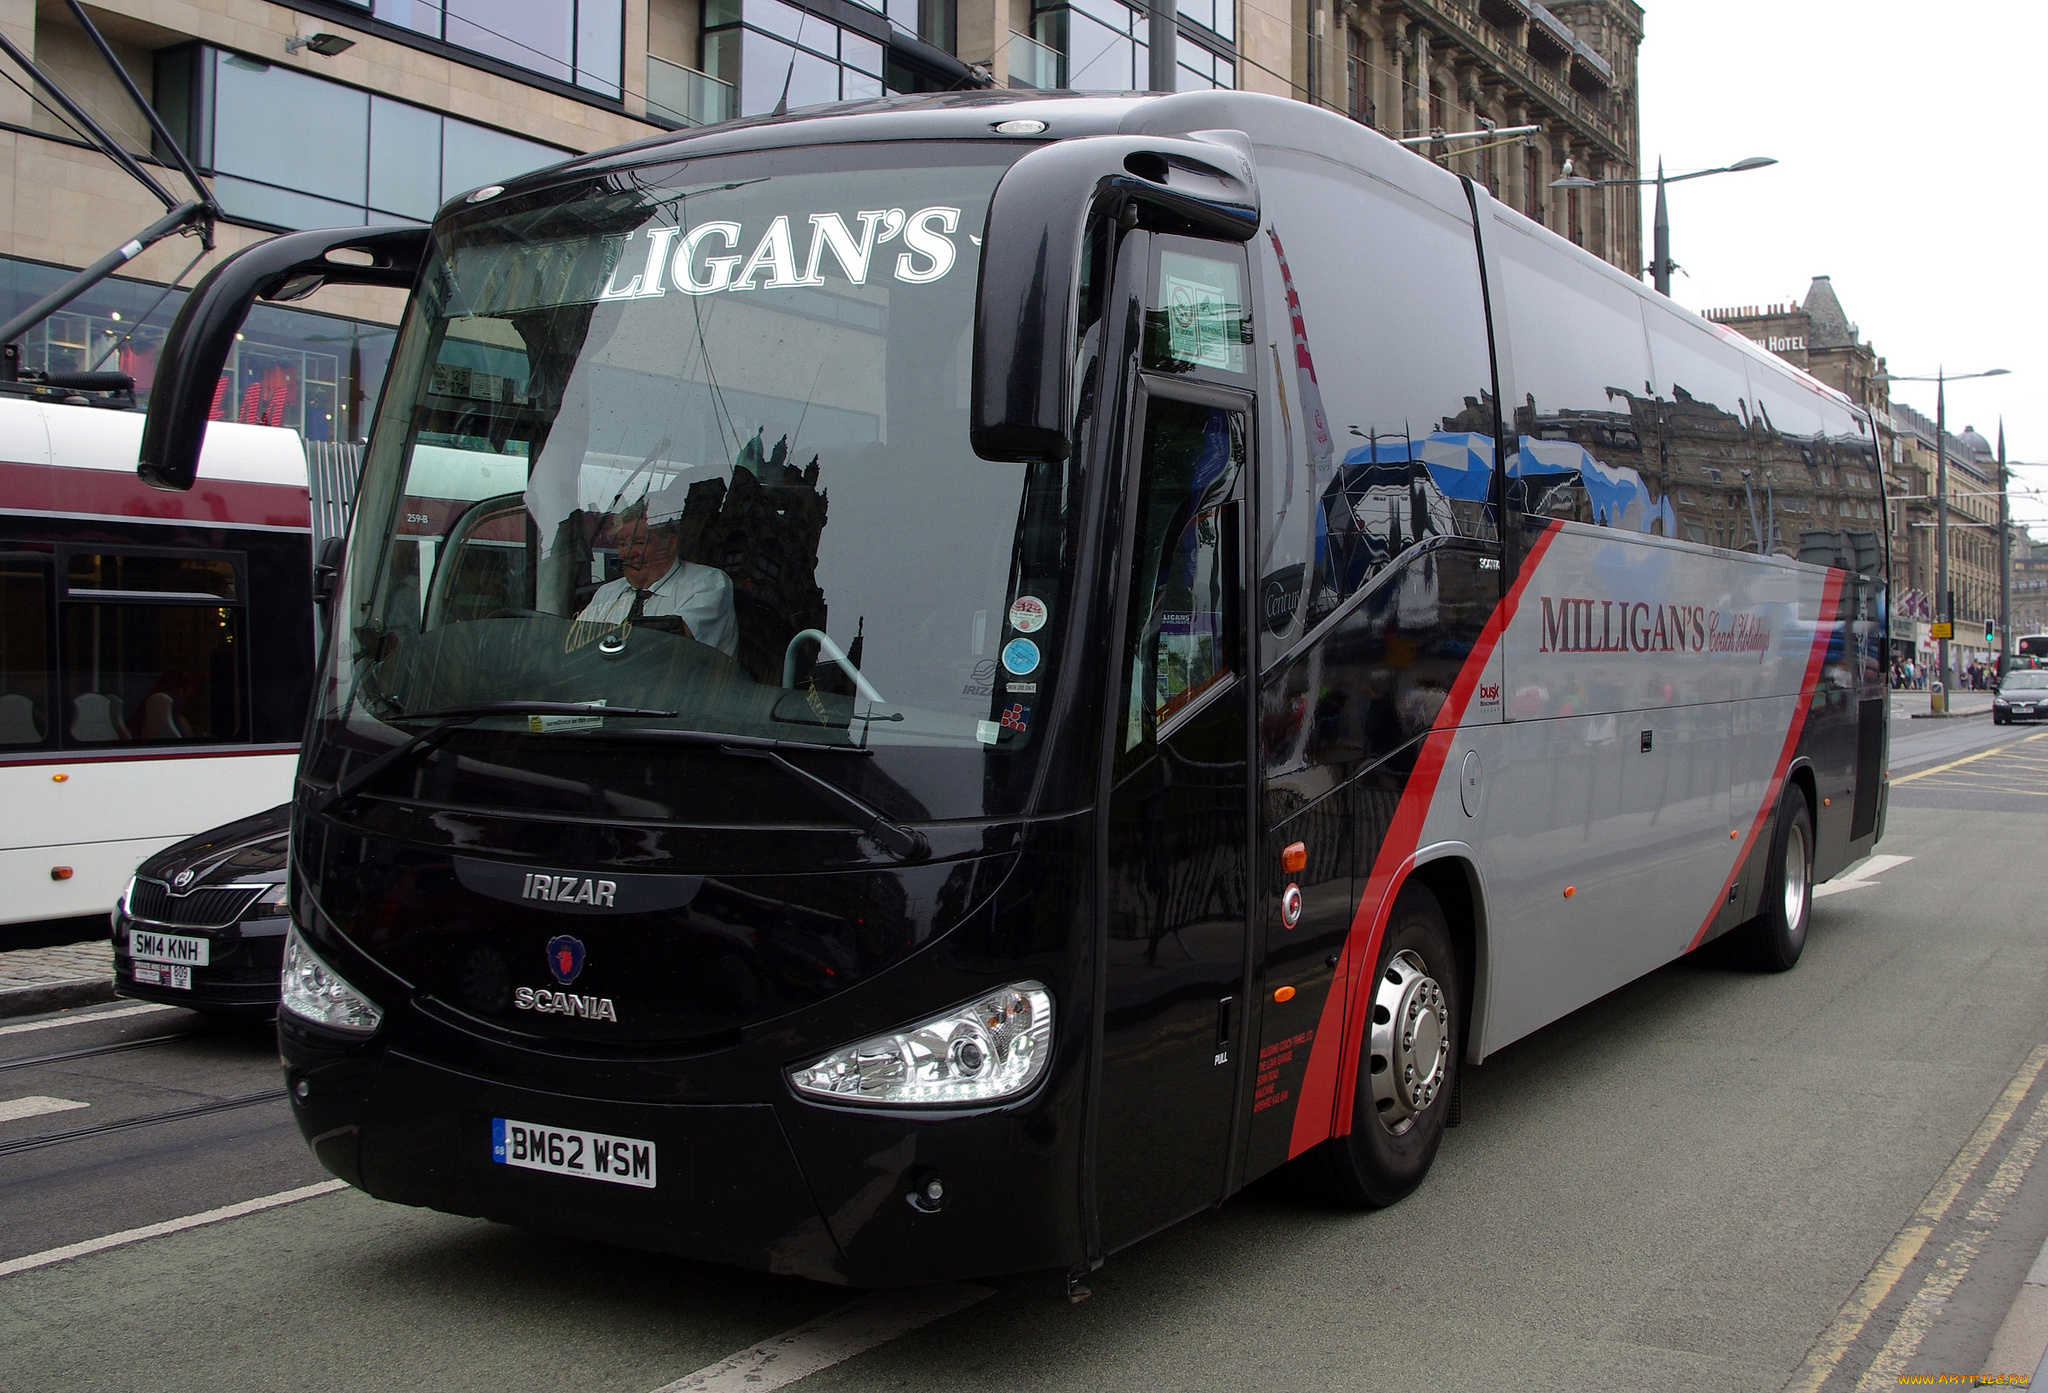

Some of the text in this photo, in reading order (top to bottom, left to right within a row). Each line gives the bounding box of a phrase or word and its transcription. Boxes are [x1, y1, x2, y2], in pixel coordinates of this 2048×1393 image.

[1768, 335, 1807, 352] HOTEL
[406, 513, 429, 524] 259-B
[1539, 596, 1770, 664] MILLIGAN'S Coach Holidays
[1479, 683, 1500, 700] busk
[522, 872, 617, 908] IRIZAR
[136, 933, 198, 961] SM14 KNH
[174, 966, 188, 979] 809
[514, 986, 618, 1023] SCANIA
[1213, 1051, 1228, 1066] PULL
[511, 1126, 650, 1180] BM62 WSM
